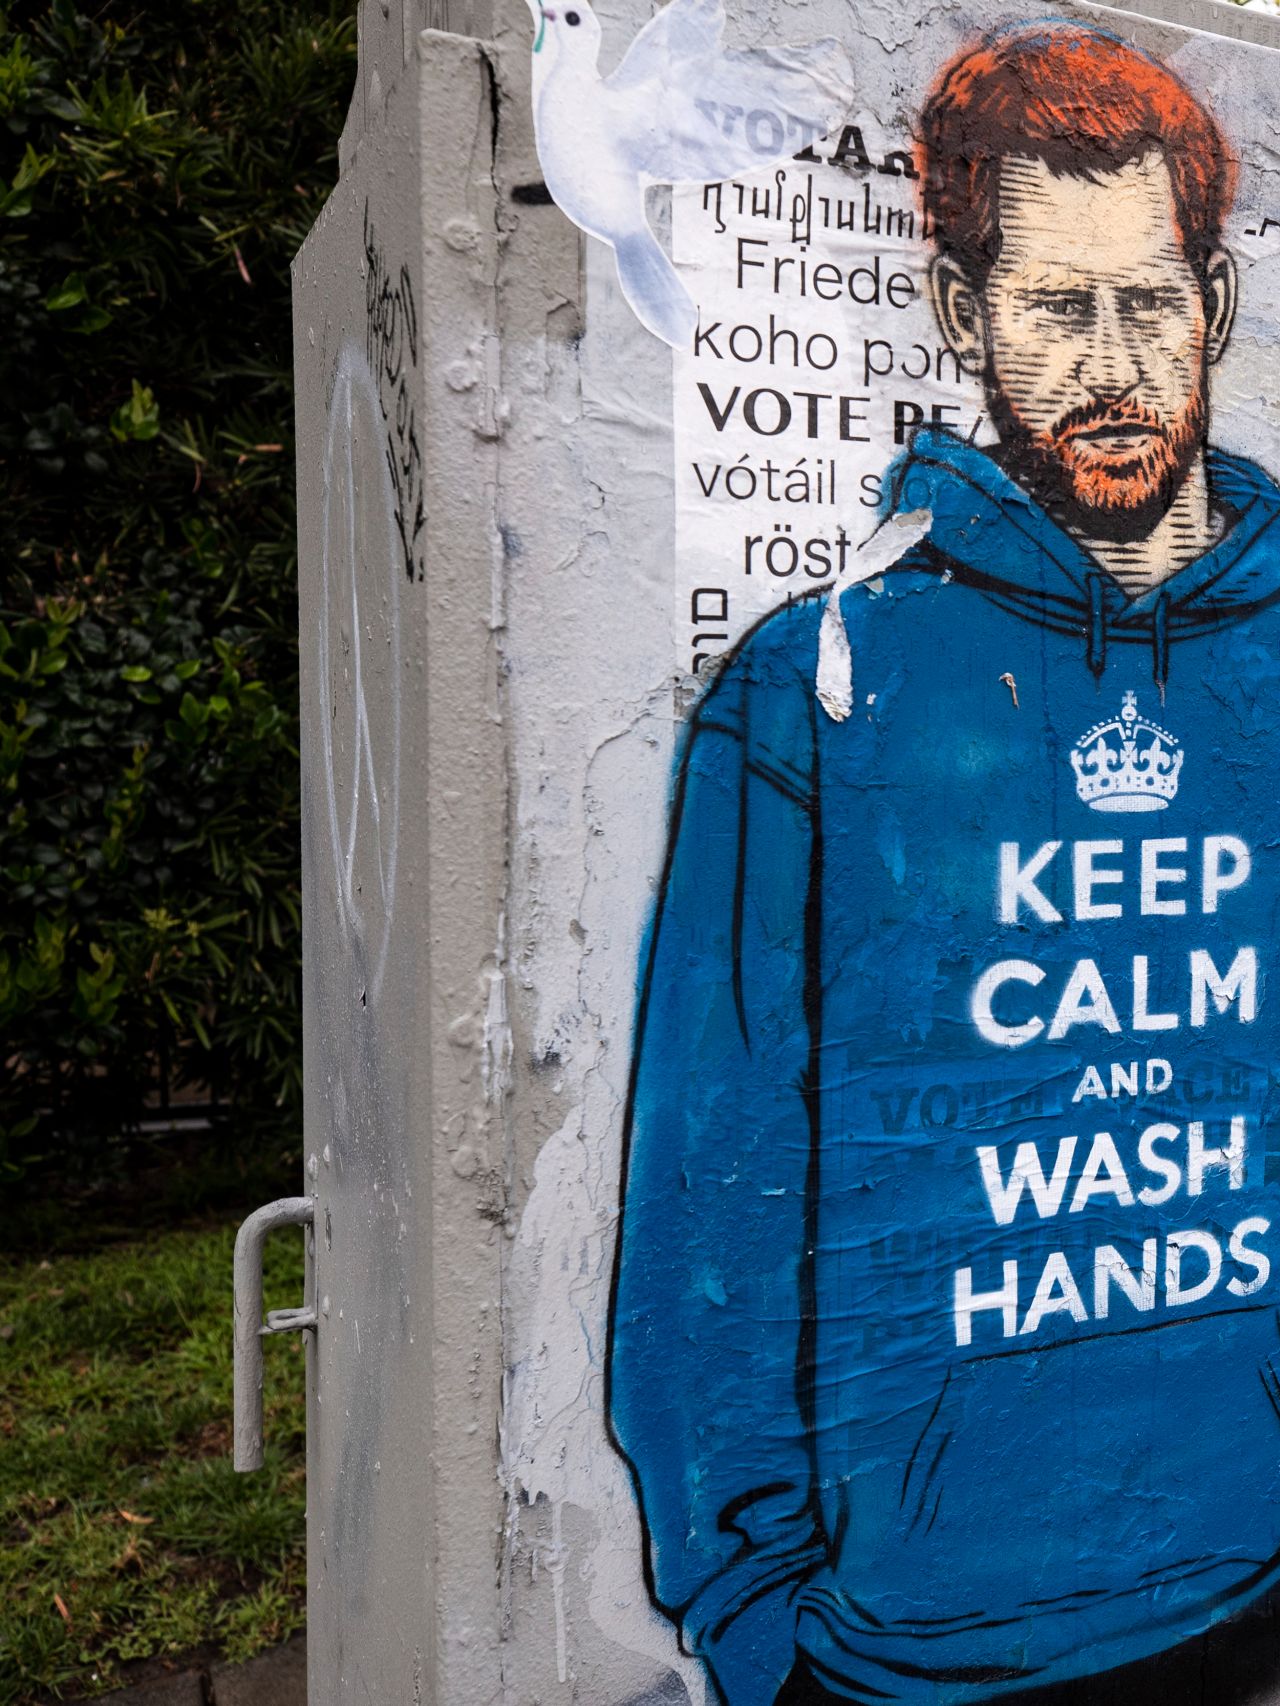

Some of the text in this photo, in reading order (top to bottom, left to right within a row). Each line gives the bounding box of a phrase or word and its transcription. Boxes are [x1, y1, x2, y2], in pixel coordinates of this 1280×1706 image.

[737, 238, 916, 309] Friede
[694, 305, 838, 370] koho
[696, 382, 871, 442] VOTE
[692, 454, 836, 505] vótáil
[997, 835, 1253, 924] KEEP
[970, 946, 1258, 1049] CALM
[1072, 1058, 1173, 1103] AND
[975, 1115, 1246, 1226] WASH
[953, 1217, 1272, 1347] HANDS
